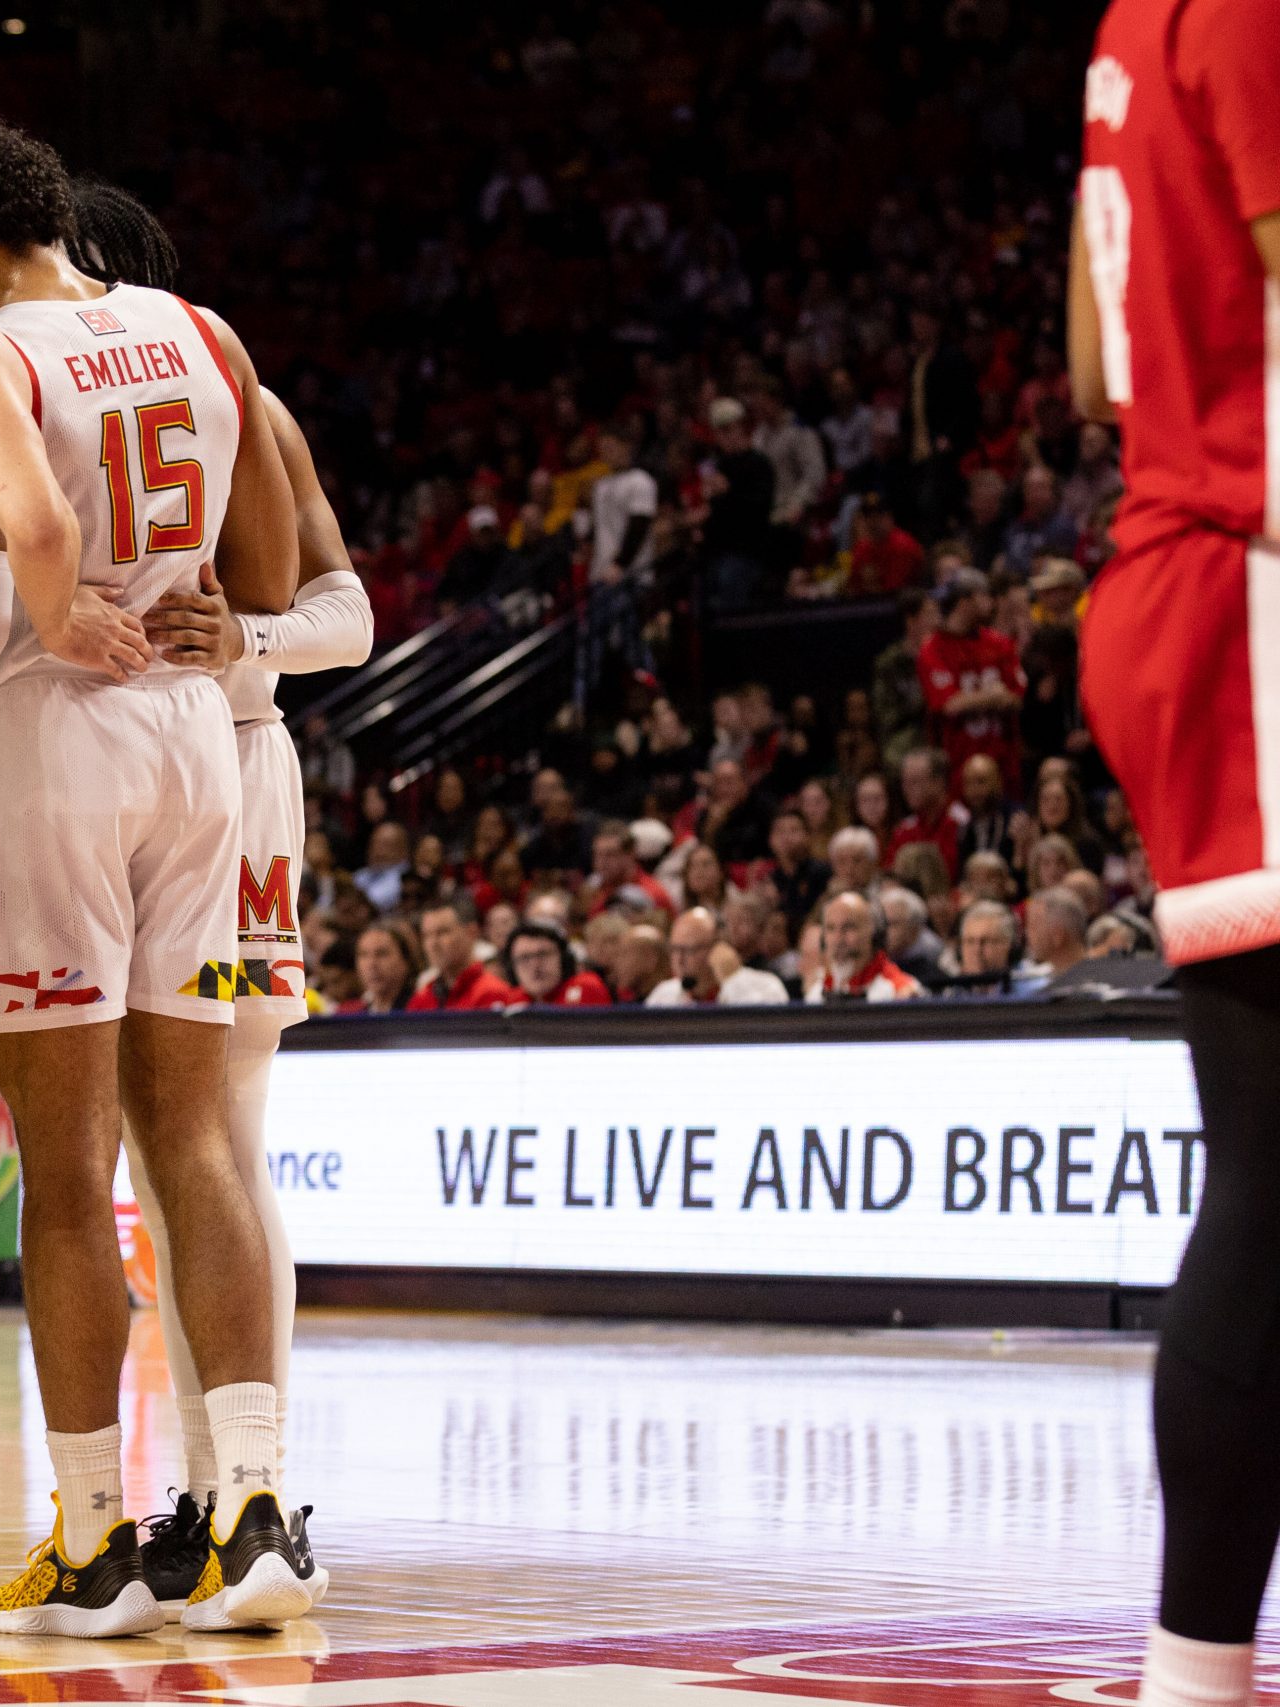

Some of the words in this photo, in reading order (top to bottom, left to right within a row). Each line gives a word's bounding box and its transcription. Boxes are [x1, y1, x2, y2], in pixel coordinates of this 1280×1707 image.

[80, 309, 123, 333] 50
[64, 341, 189, 393] EMILIEN
[99, 397, 205, 565] 15
[238, 855, 296, 931] M
[436, 1127, 539, 1207] WE
[563, 1127, 717, 1209] LIVE
[740, 1127, 914, 1212] AND
[943, 1127, 1204, 1216] BREAT
